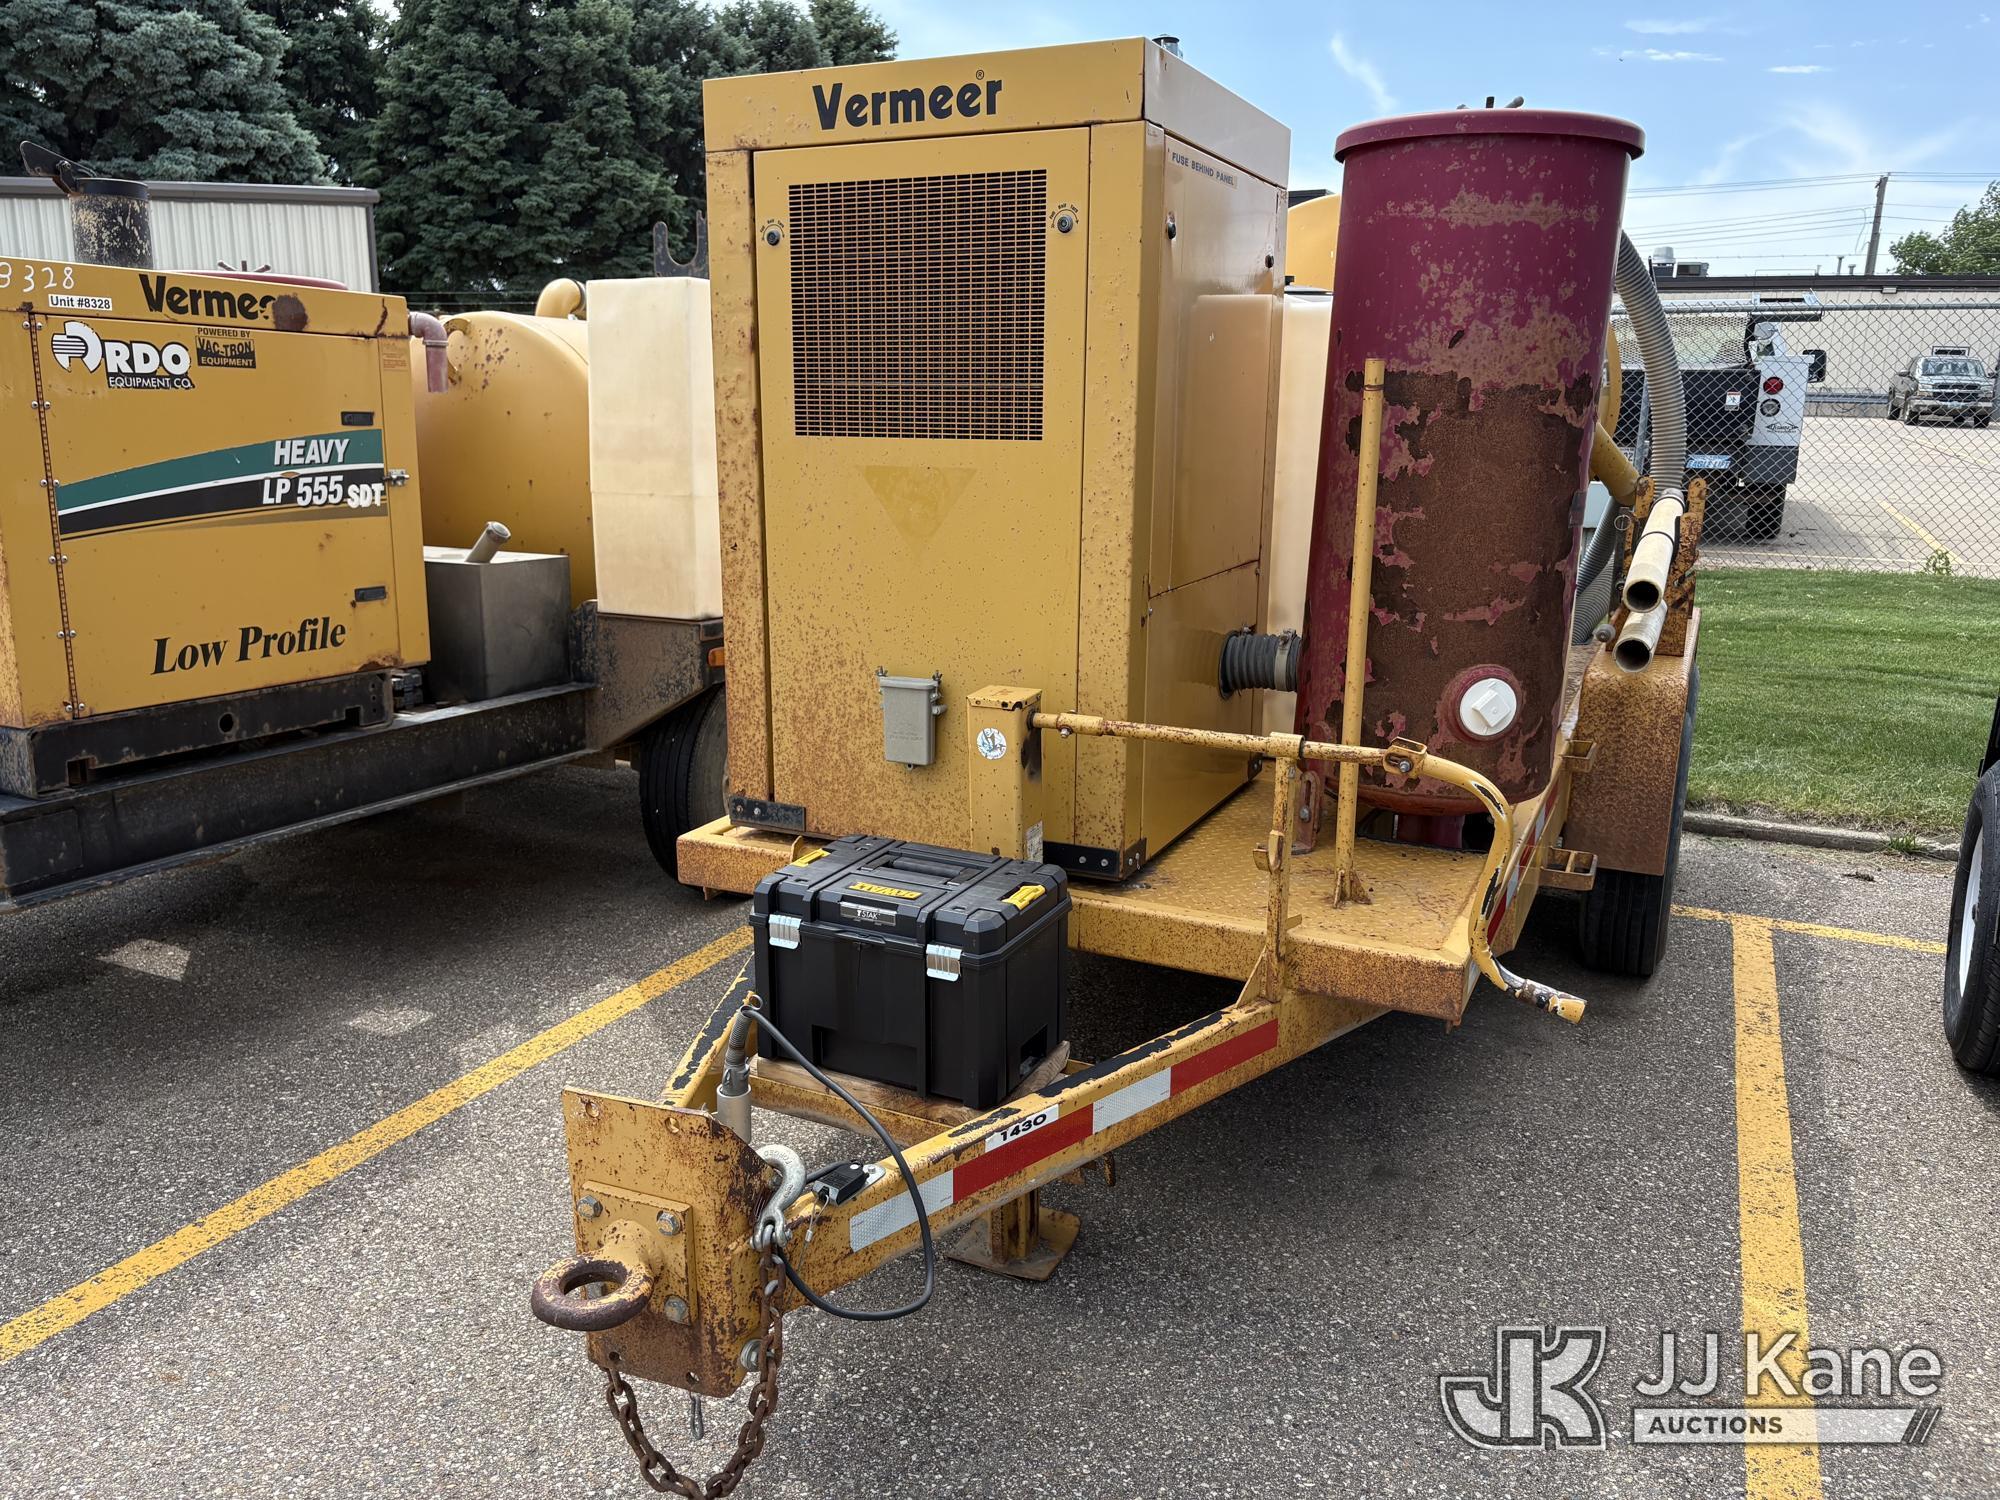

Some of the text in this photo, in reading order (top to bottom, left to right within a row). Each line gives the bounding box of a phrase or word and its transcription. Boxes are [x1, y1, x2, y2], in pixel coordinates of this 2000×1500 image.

[1171, 152, 1234, 186] FUSE BEHIND PANEL
[50, 295, 111, 310] Unit #8328
[197, 327, 251, 338] POWERED BY
[103, 341, 191, 376] RDO
[198, 336, 253, 358] VAC-TRON
[200, 356, 254, 367] EQUIPMENT
[108, 376, 194, 389] EQUIPMENT CO.
[274, 438, 350, 466] HEAVY
[262, 475, 385, 509] LP 555 SDT
[150, 616, 346, 676] Low Profile
[1000, 1113, 1047, 1142] 1430
